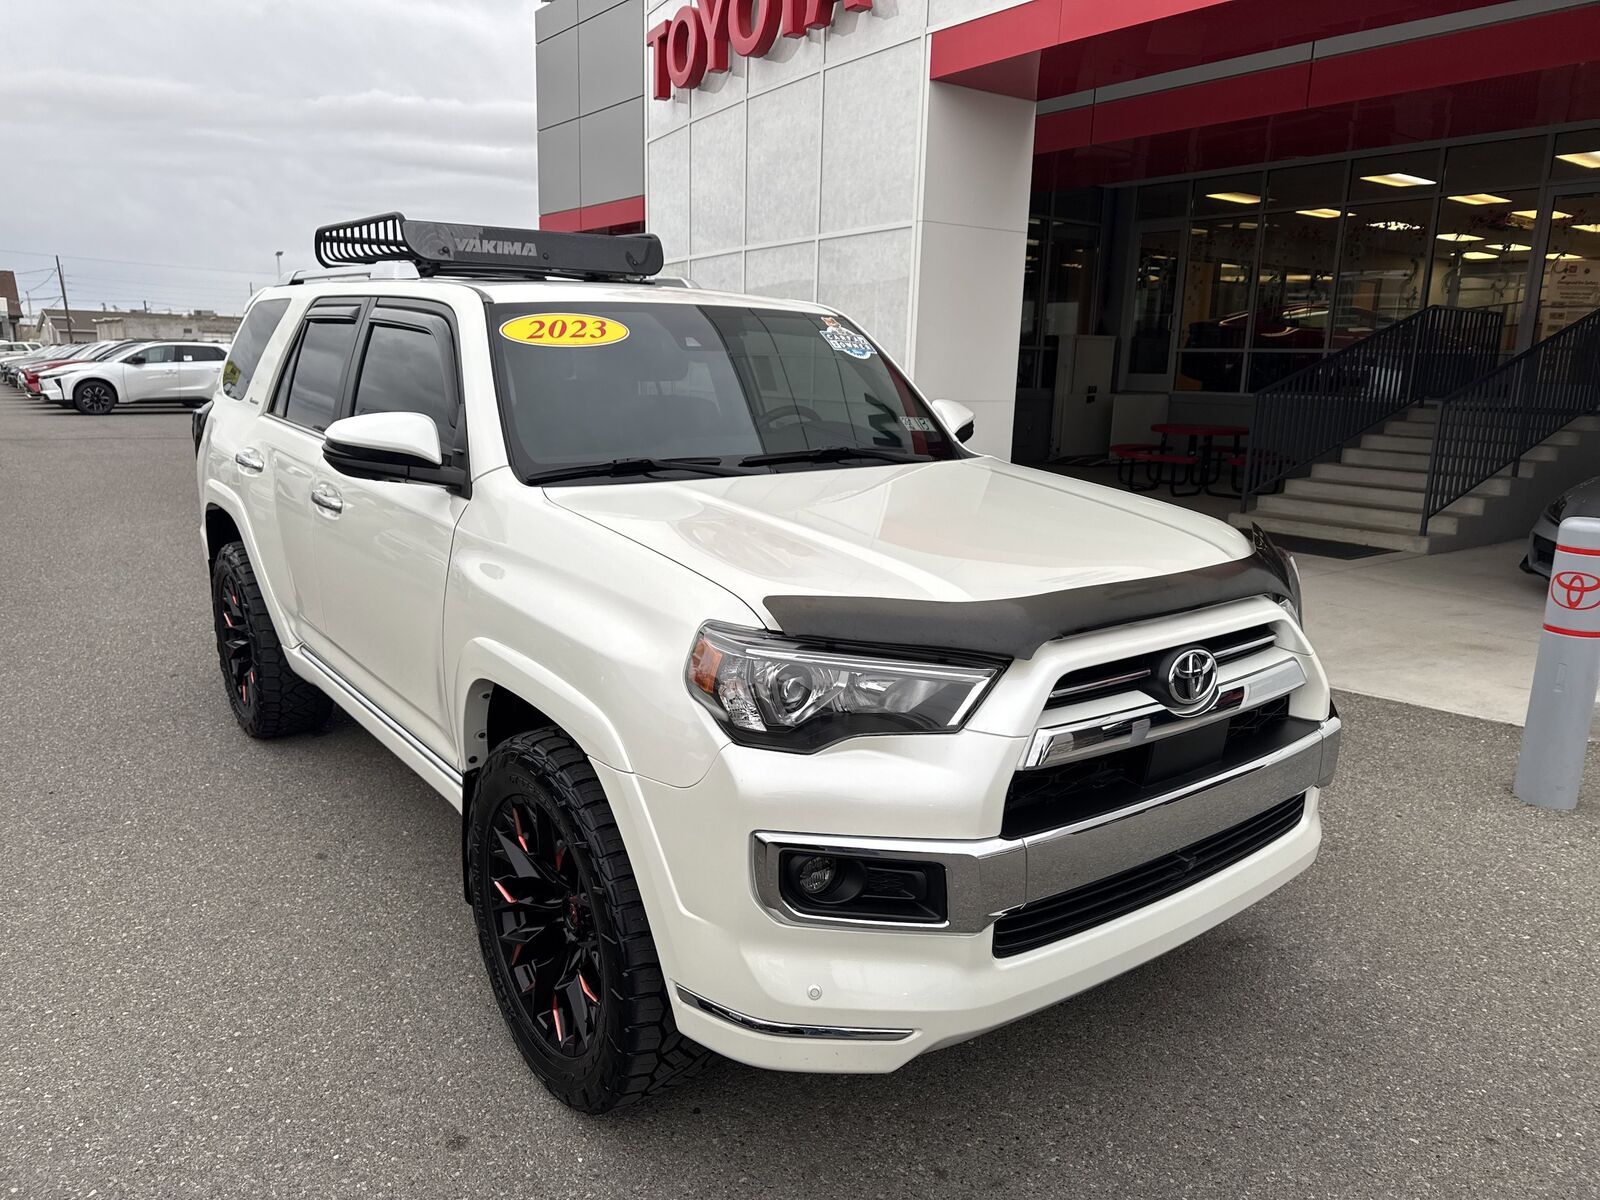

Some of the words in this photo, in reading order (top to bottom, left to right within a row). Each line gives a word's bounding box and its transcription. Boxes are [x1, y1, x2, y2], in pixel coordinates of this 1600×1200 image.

[647, 0, 873, 100] TOYO
[454, 238, 537, 257] YAKIMA
[526, 319, 607, 339] 2023
